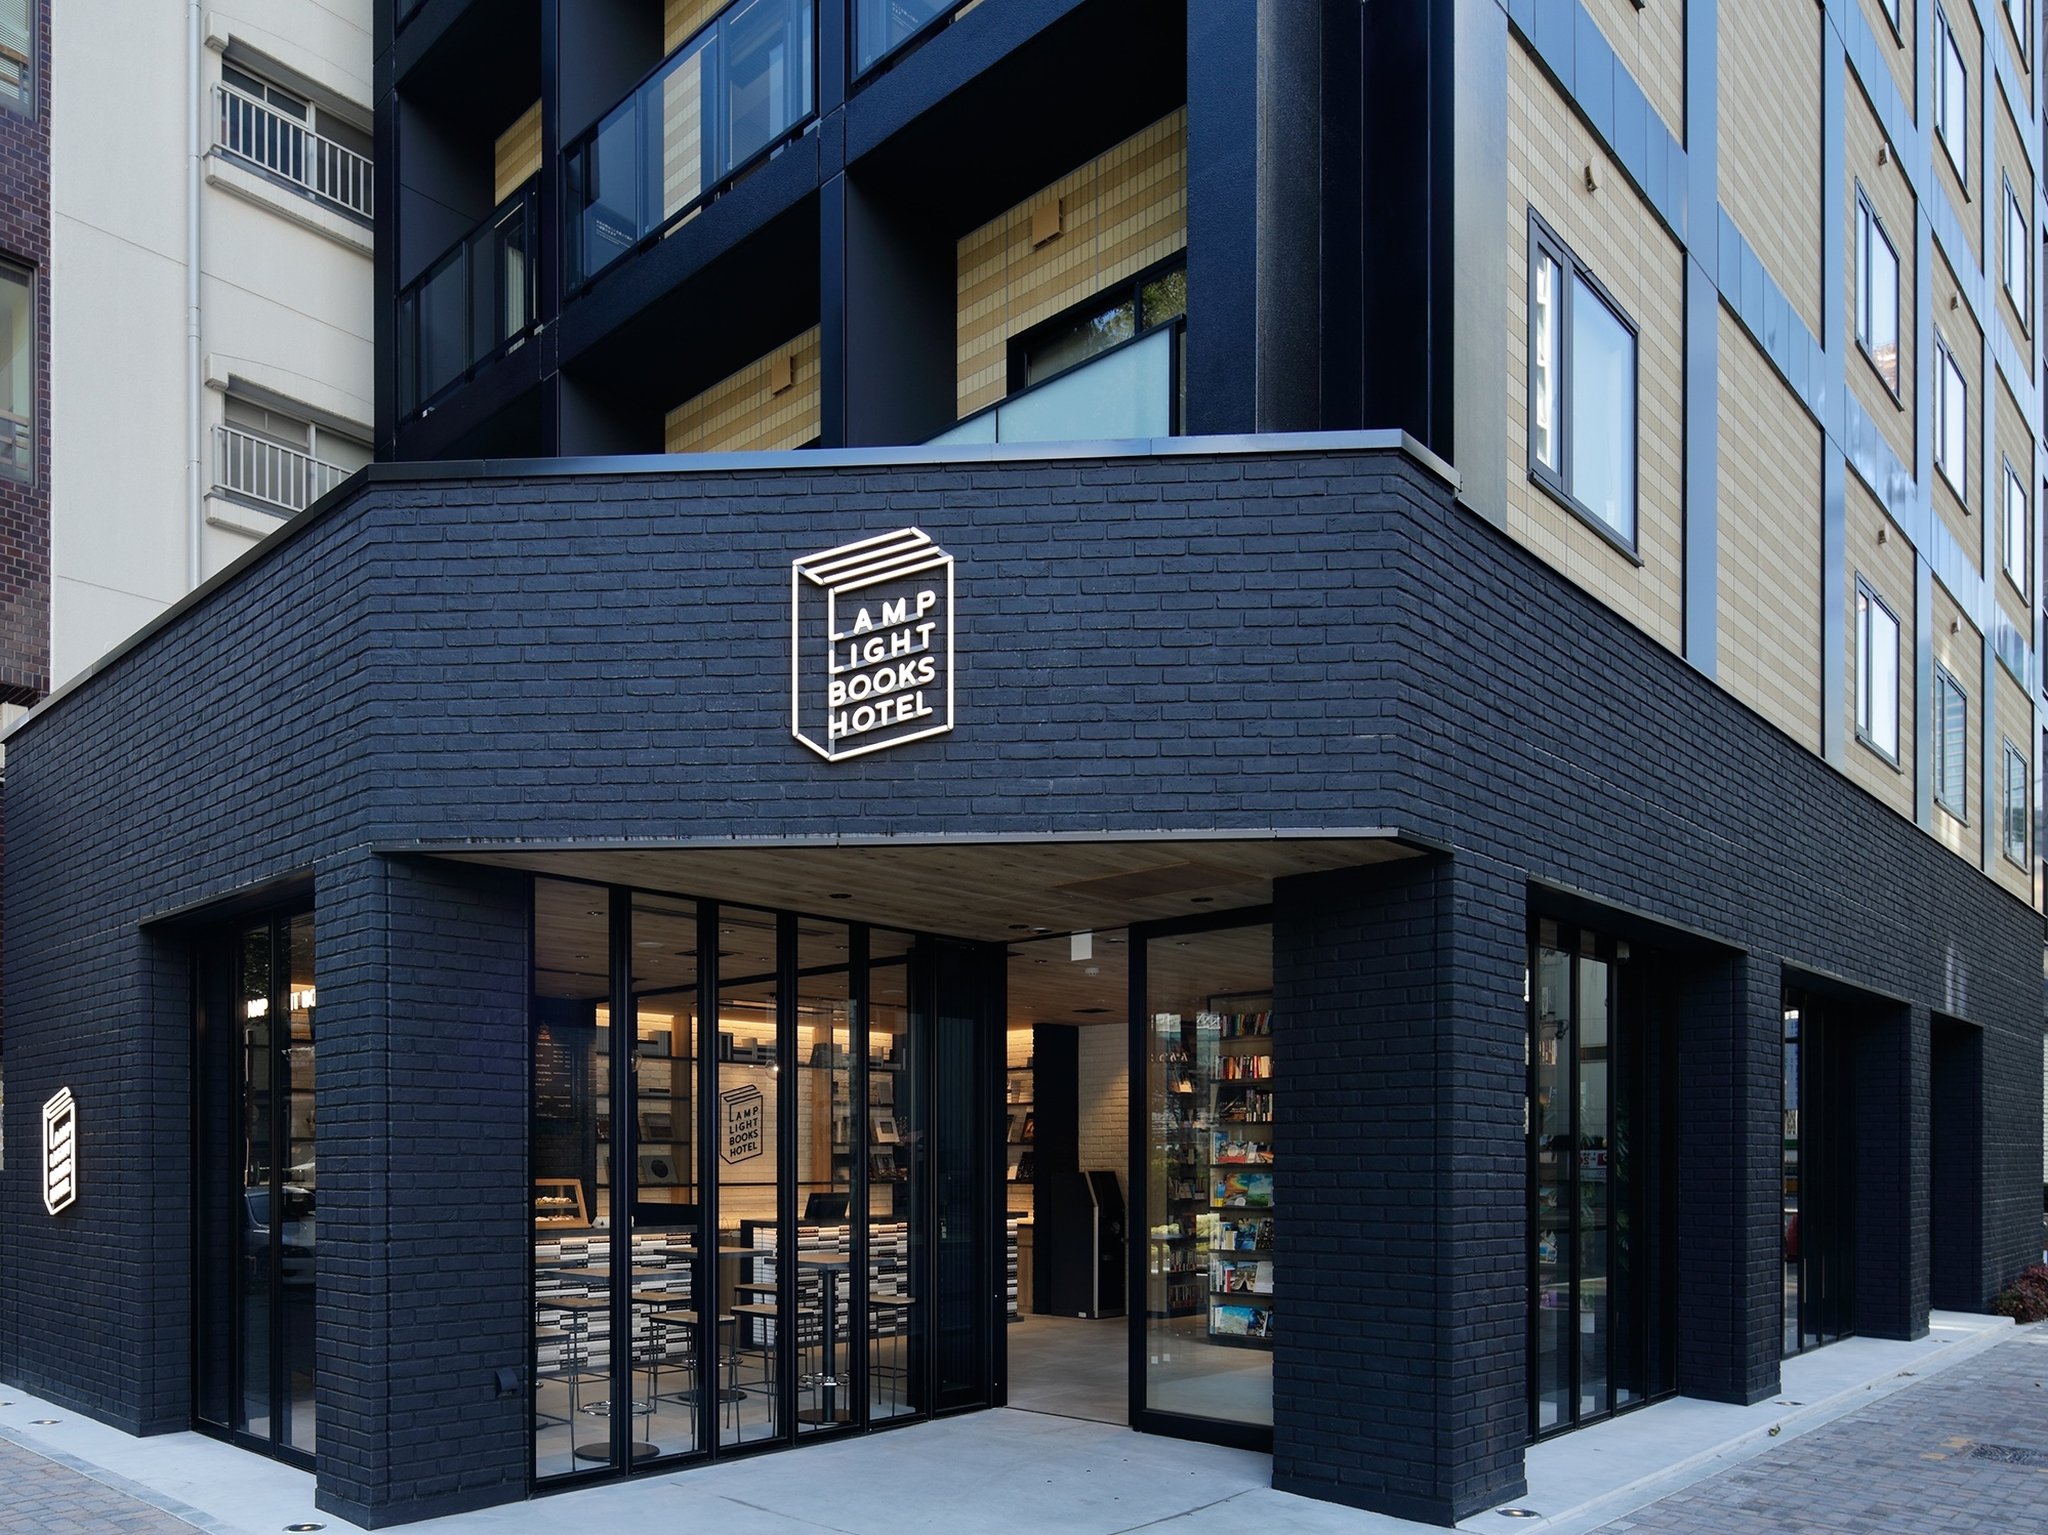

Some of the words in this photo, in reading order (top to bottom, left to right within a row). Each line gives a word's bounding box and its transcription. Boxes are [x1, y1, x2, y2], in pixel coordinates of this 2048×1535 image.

[829, 588, 936, 641] LAMP
[829, 622, 936, 674] LIGHT
[828, 656, 935, 708] BOOKS
[828, 690, 933, 740] HOTEL
[729, 1118, 758, 1134] LIGHT
[730, 1105, 758, 1122] LAMP
[729, 1129, 758, 1145] BOOKS
[730, 1141, 757, 1157] HOTEL
